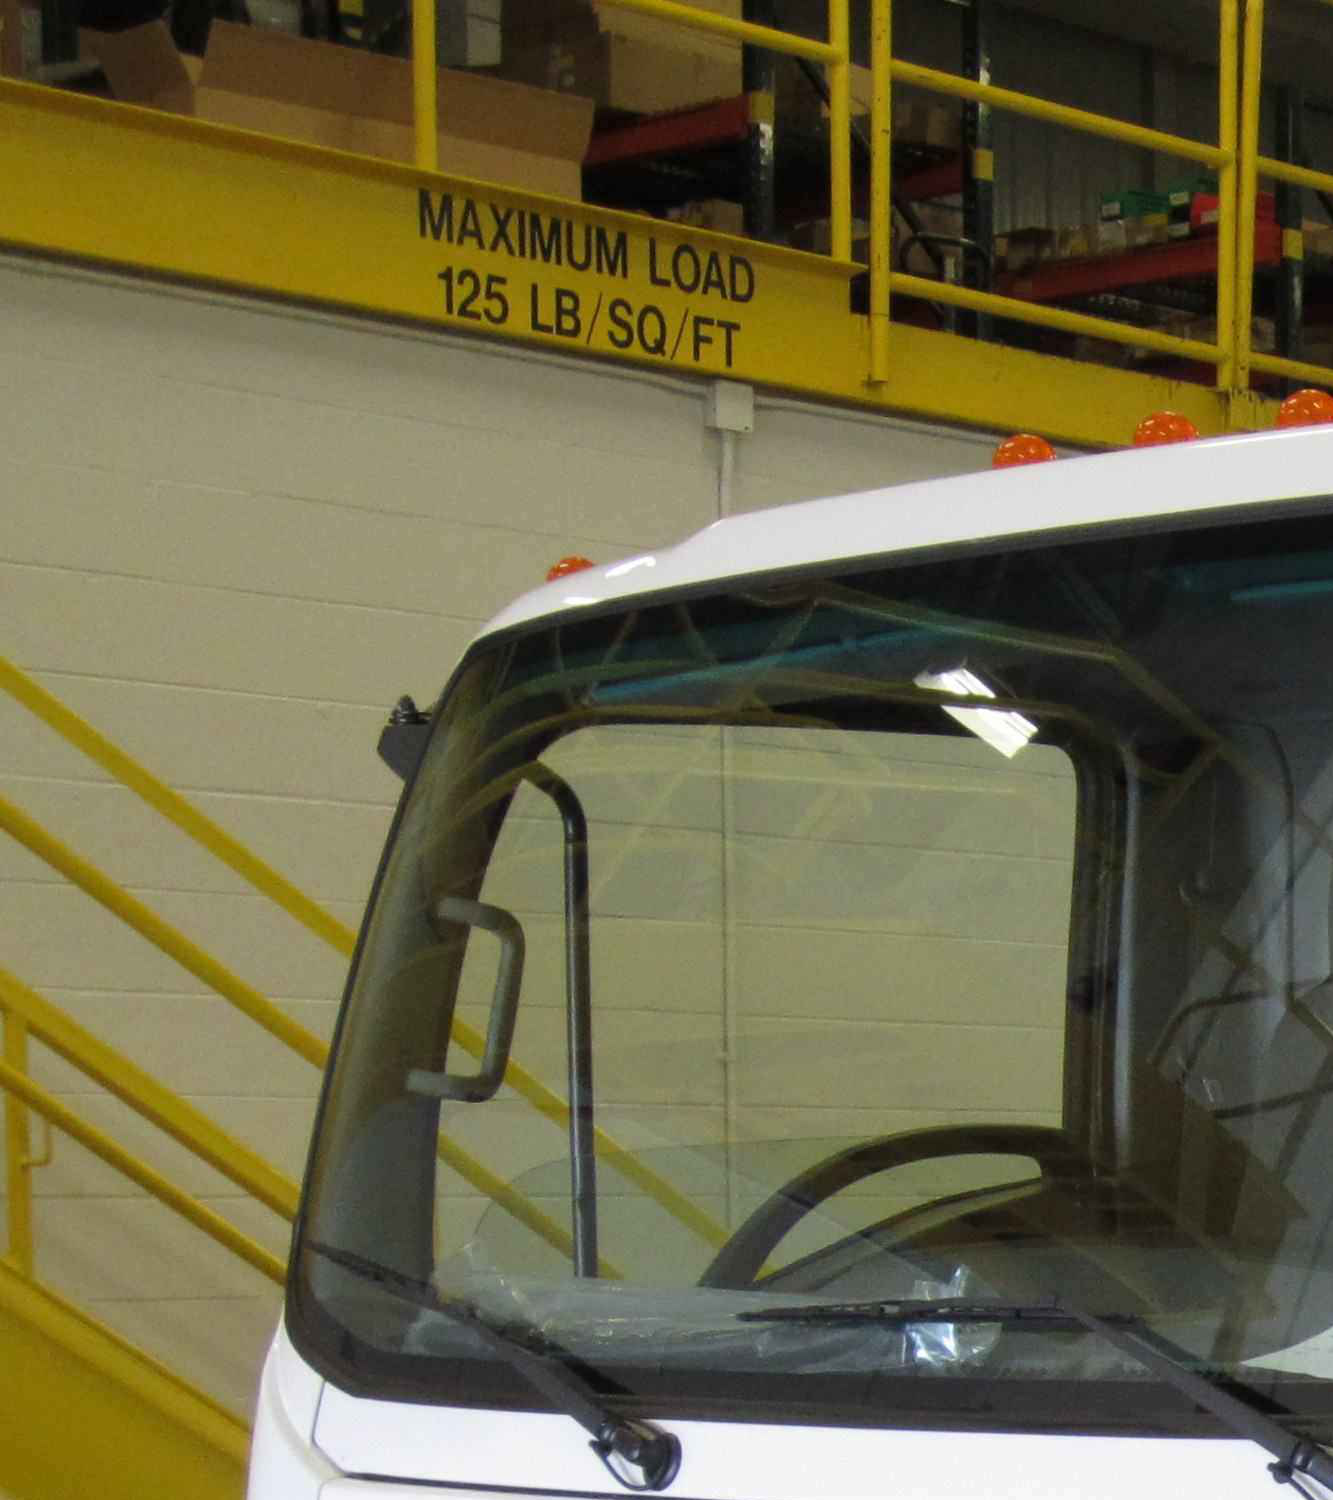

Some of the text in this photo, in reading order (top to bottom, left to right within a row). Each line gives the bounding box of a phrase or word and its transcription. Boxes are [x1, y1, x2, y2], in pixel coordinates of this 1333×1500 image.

[418, 188, 755, 304] MAXIMUM LOAD
[437, 265, 741, 368] 125 LB/SQ/FT
